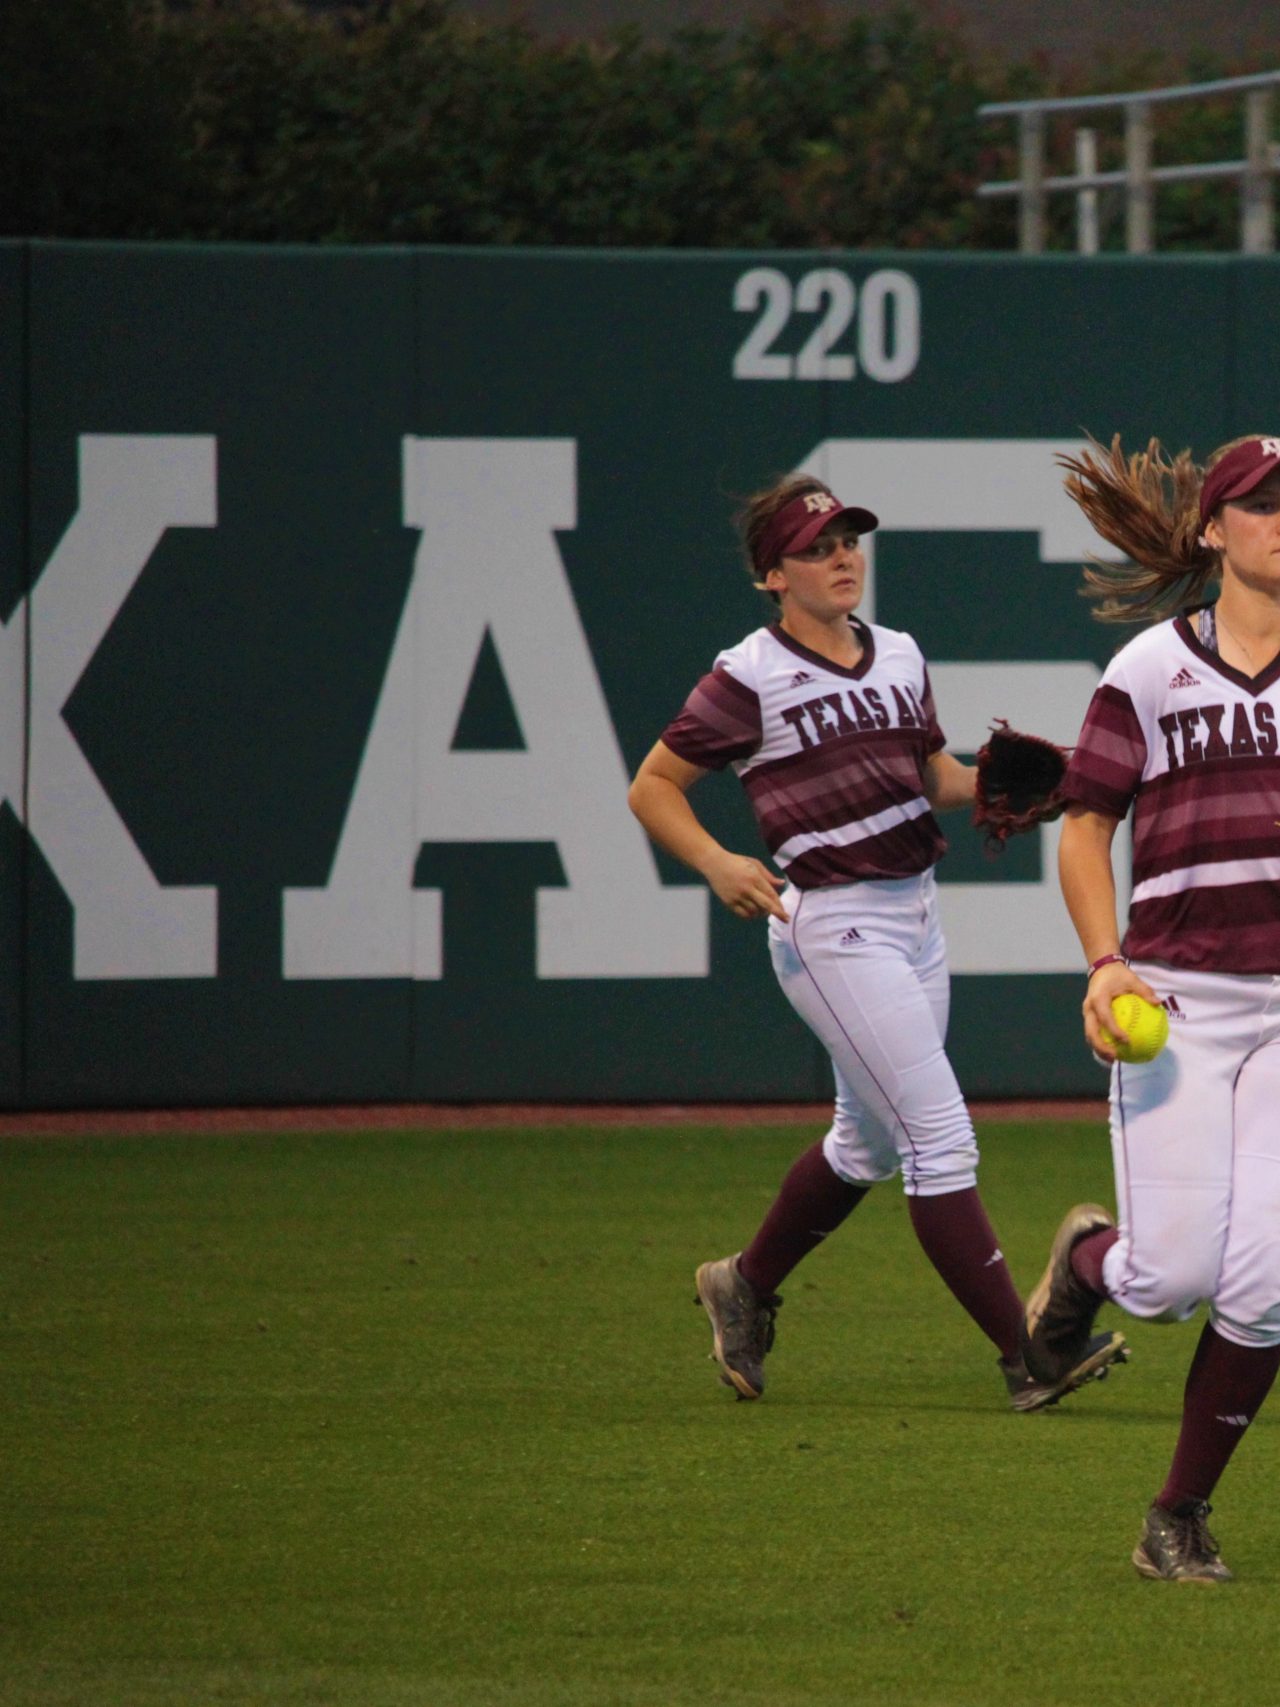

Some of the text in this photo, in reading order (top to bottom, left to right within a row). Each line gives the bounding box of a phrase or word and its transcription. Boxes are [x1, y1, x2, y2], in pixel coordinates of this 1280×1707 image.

[733, 267, 922, 384] 220
[780, 687, 891, 751] TEXAS
[1158, 701, 1279, 771] TEXAS
